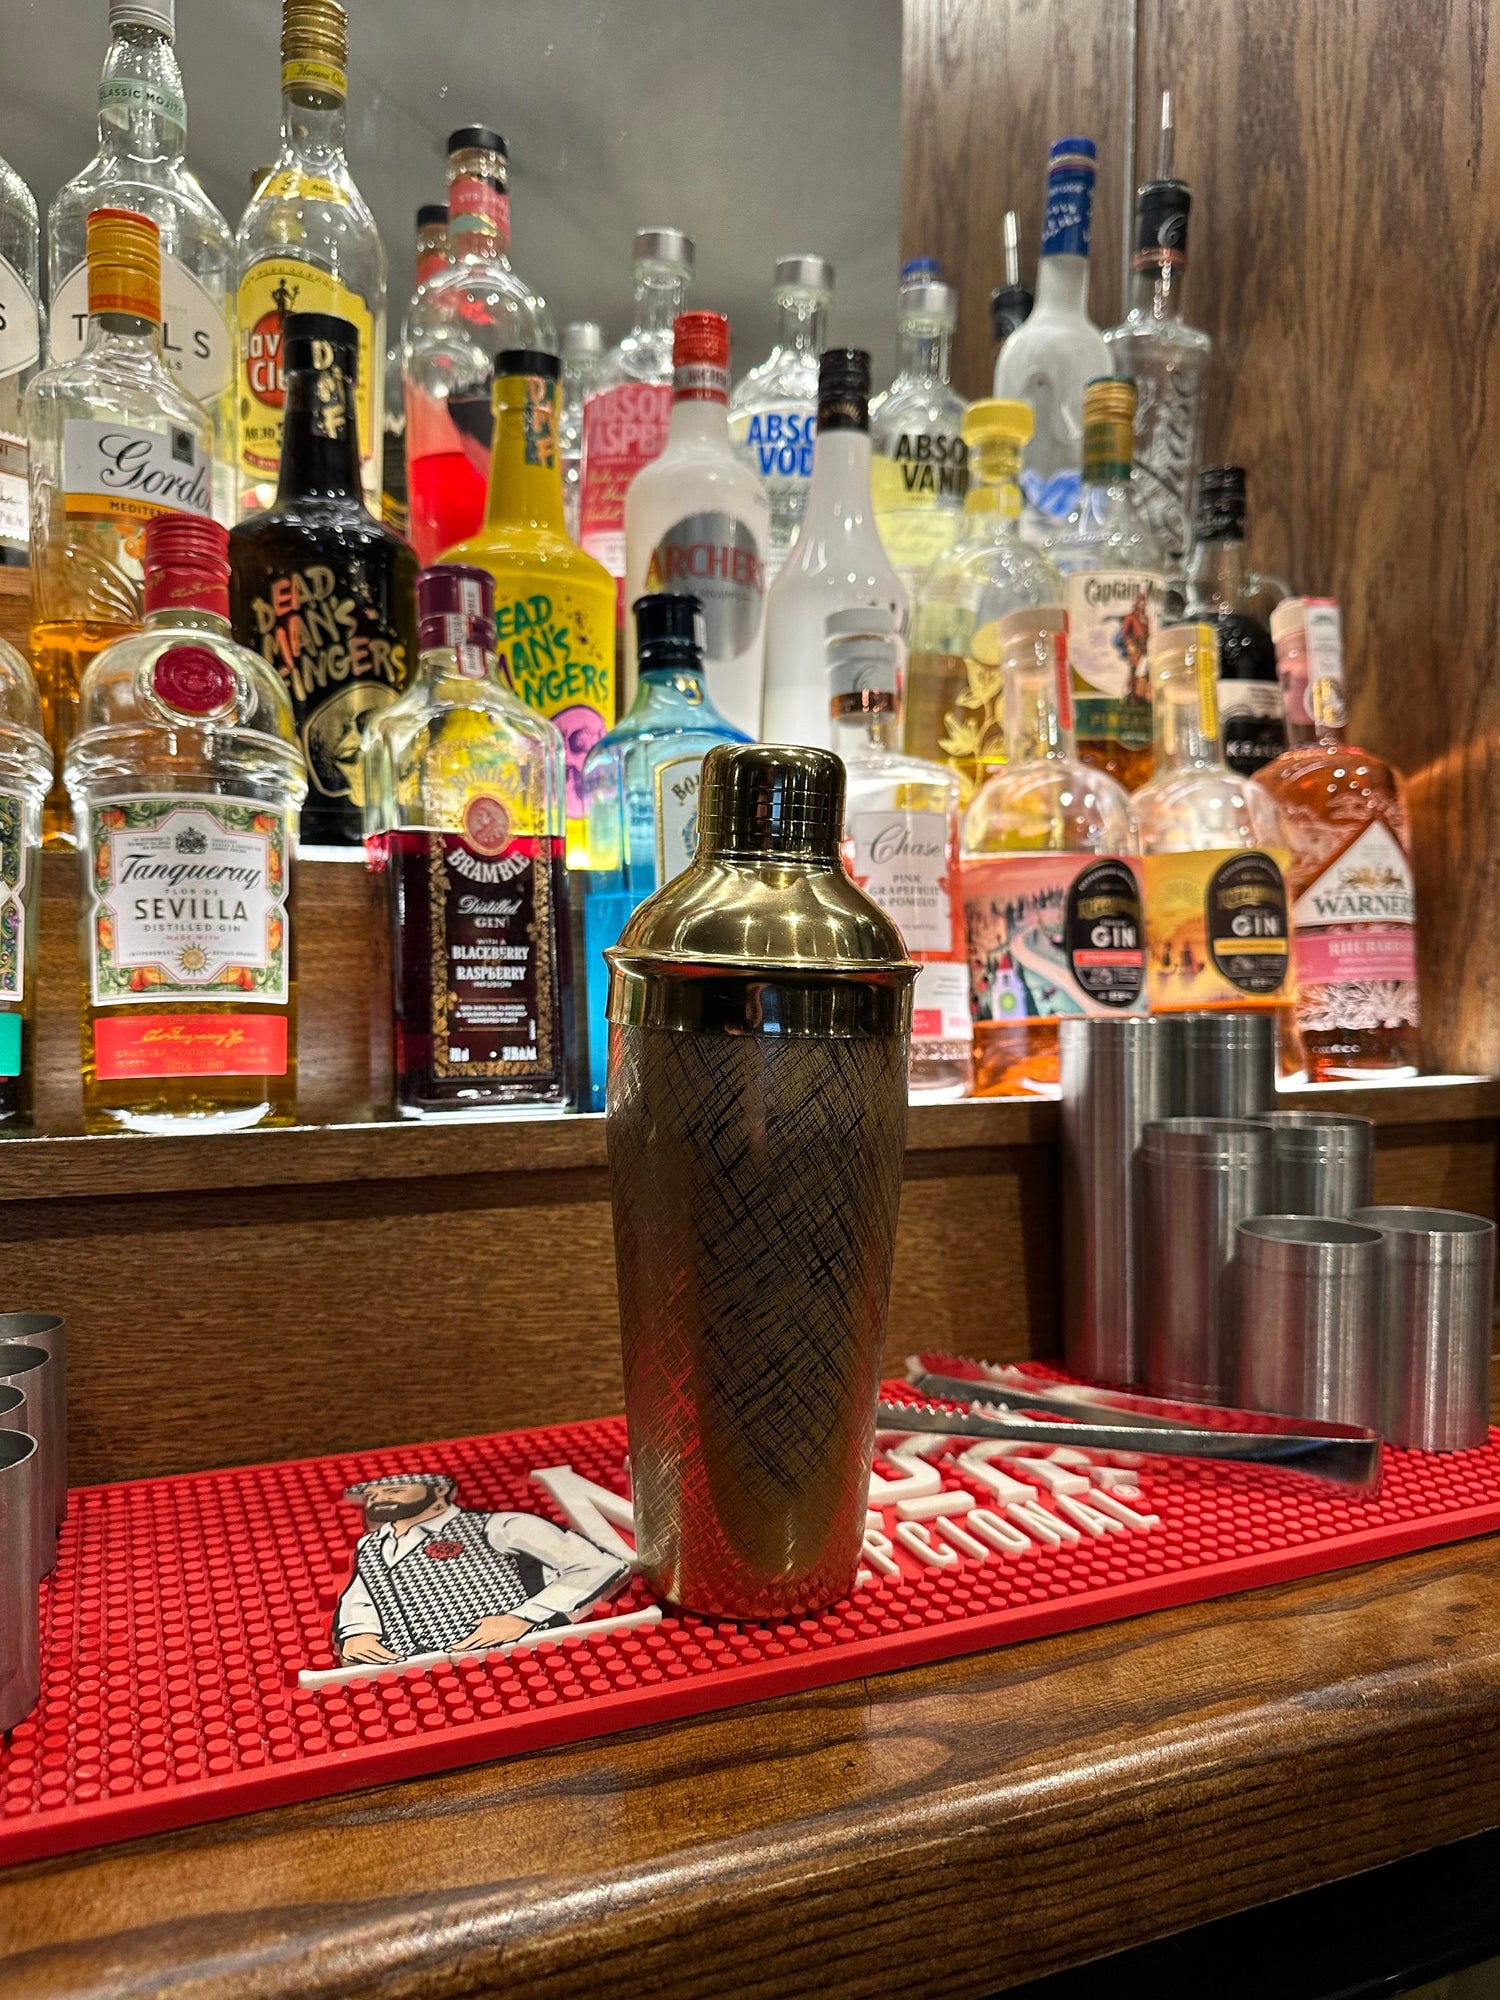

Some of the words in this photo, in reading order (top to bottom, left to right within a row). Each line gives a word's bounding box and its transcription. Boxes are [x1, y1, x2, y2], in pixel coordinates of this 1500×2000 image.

[99, 88, 141, 100] CLASSIC
[71, 313, 211, 359] TLS
[747, 414, 817, 446] ABSO
[758, 447, 815, 476] VOD
[895, 434, 969, 463] ABSO
[250, 564, 336, 635] DEAD
[496, 595, 563, 639] EAD
[523, 663, 608, 710] NGERS
[868, 824, 942, 864] Chase
[119, 854, 262, 891] Tanqueray
[446, 848, 531, 884] BRAMBLE
[135, 898, 248, 922] SEVILLA
[456, 894, 523, 915] Distilled
[144, 924, 213, 932] DISTILLED
[219, 925, 241, 933] GIN
[1090, 925, 1137, 948] GIN
[1231, 914, 1281, 937] GIN
[451, 946, 530, 960] BLACKBERRY
[455, 965, 527, 981] RASPBERRY
[857, 1488, 1161, 1587] PCIONAL
